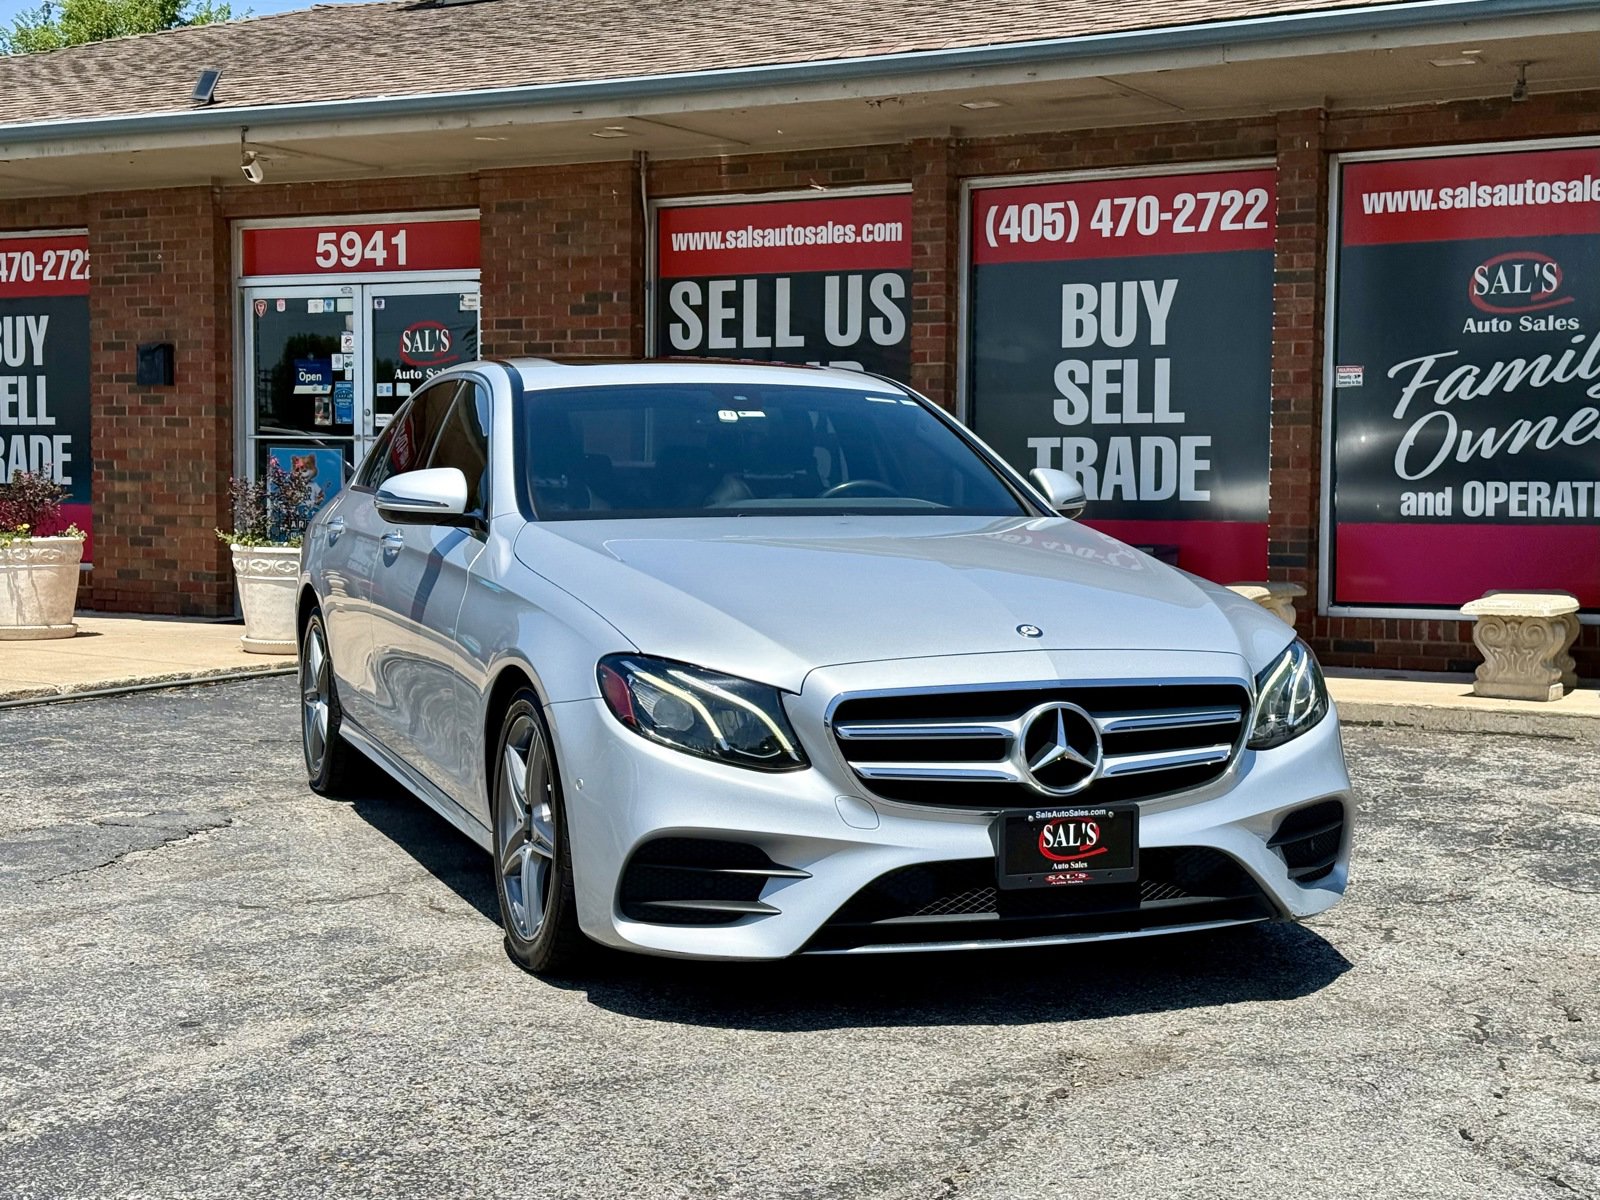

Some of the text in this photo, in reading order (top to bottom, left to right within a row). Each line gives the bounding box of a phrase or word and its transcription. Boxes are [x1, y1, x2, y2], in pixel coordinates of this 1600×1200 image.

[985, 188, 1269, 248] (405) 470-2722
[315, 229, 407, 268] 5941
[671, 221, 903, 252] www.salsautosales.com
[1473, 262, 1558, 296] SAL'S
[669, 272, 906, 351] SELL US
[1061, 279, 1179, 348] BUY
[1462, 315, 1580, 334] Auto Sales
[402, 329, 450, 353] SAL'S
[298, 371, 322, 383] Open
[394, 369, 422, 380] Auto
[1387, 331, 1600, 420] Famil
[1053, 358, 1185, 426] SELL
[1394, 407, 1600, 481] Owne
[1027, 435, 1212, 502] TRADE
[1400, 487, 1453, 516] and
[1035, 809, 1106, 819] SalsAutoSales.com
[1043, 822, 1097, 848] SAL'S
[1048, 872, 1087, 880] SAL'S
[1052, 861, 1088, 870] Auto Sales
